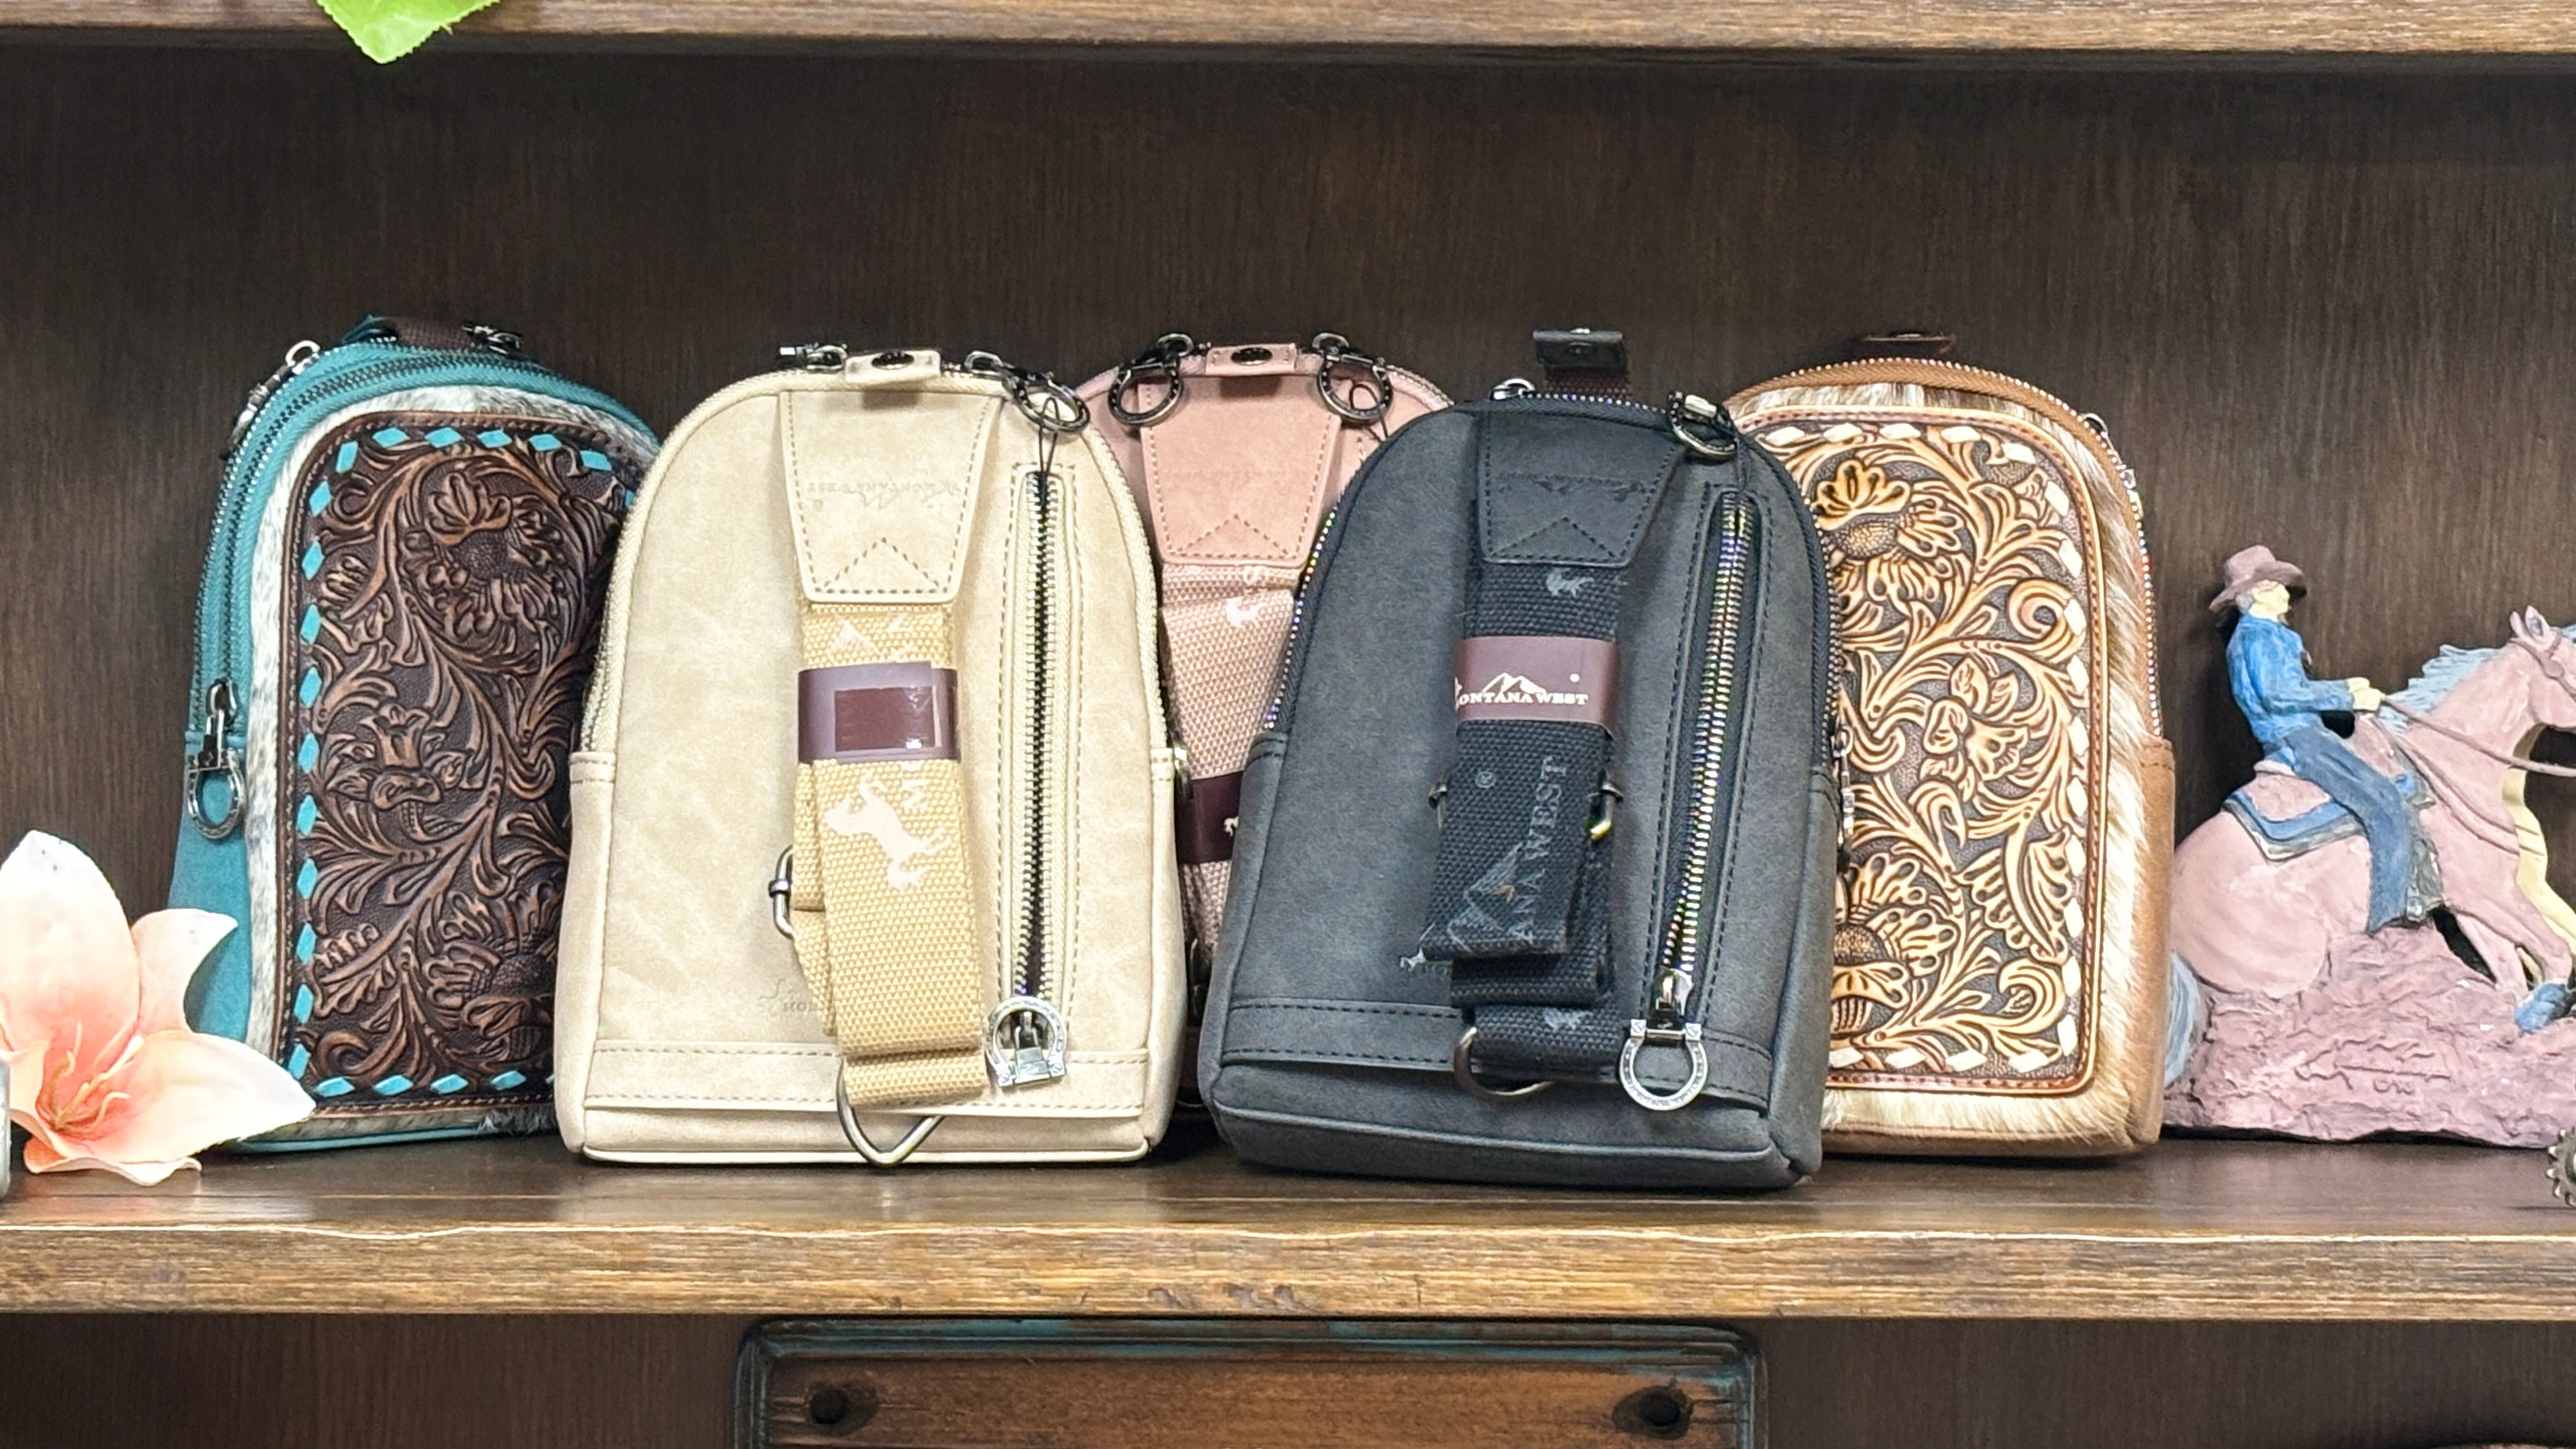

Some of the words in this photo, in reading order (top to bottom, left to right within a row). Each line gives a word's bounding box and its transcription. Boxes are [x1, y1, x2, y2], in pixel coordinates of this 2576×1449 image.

[1457, 692, 1534, 705] ONTANA
[1535, 693, 1589, 705] WEST
[1522, 755, 1566, 861] WEST
